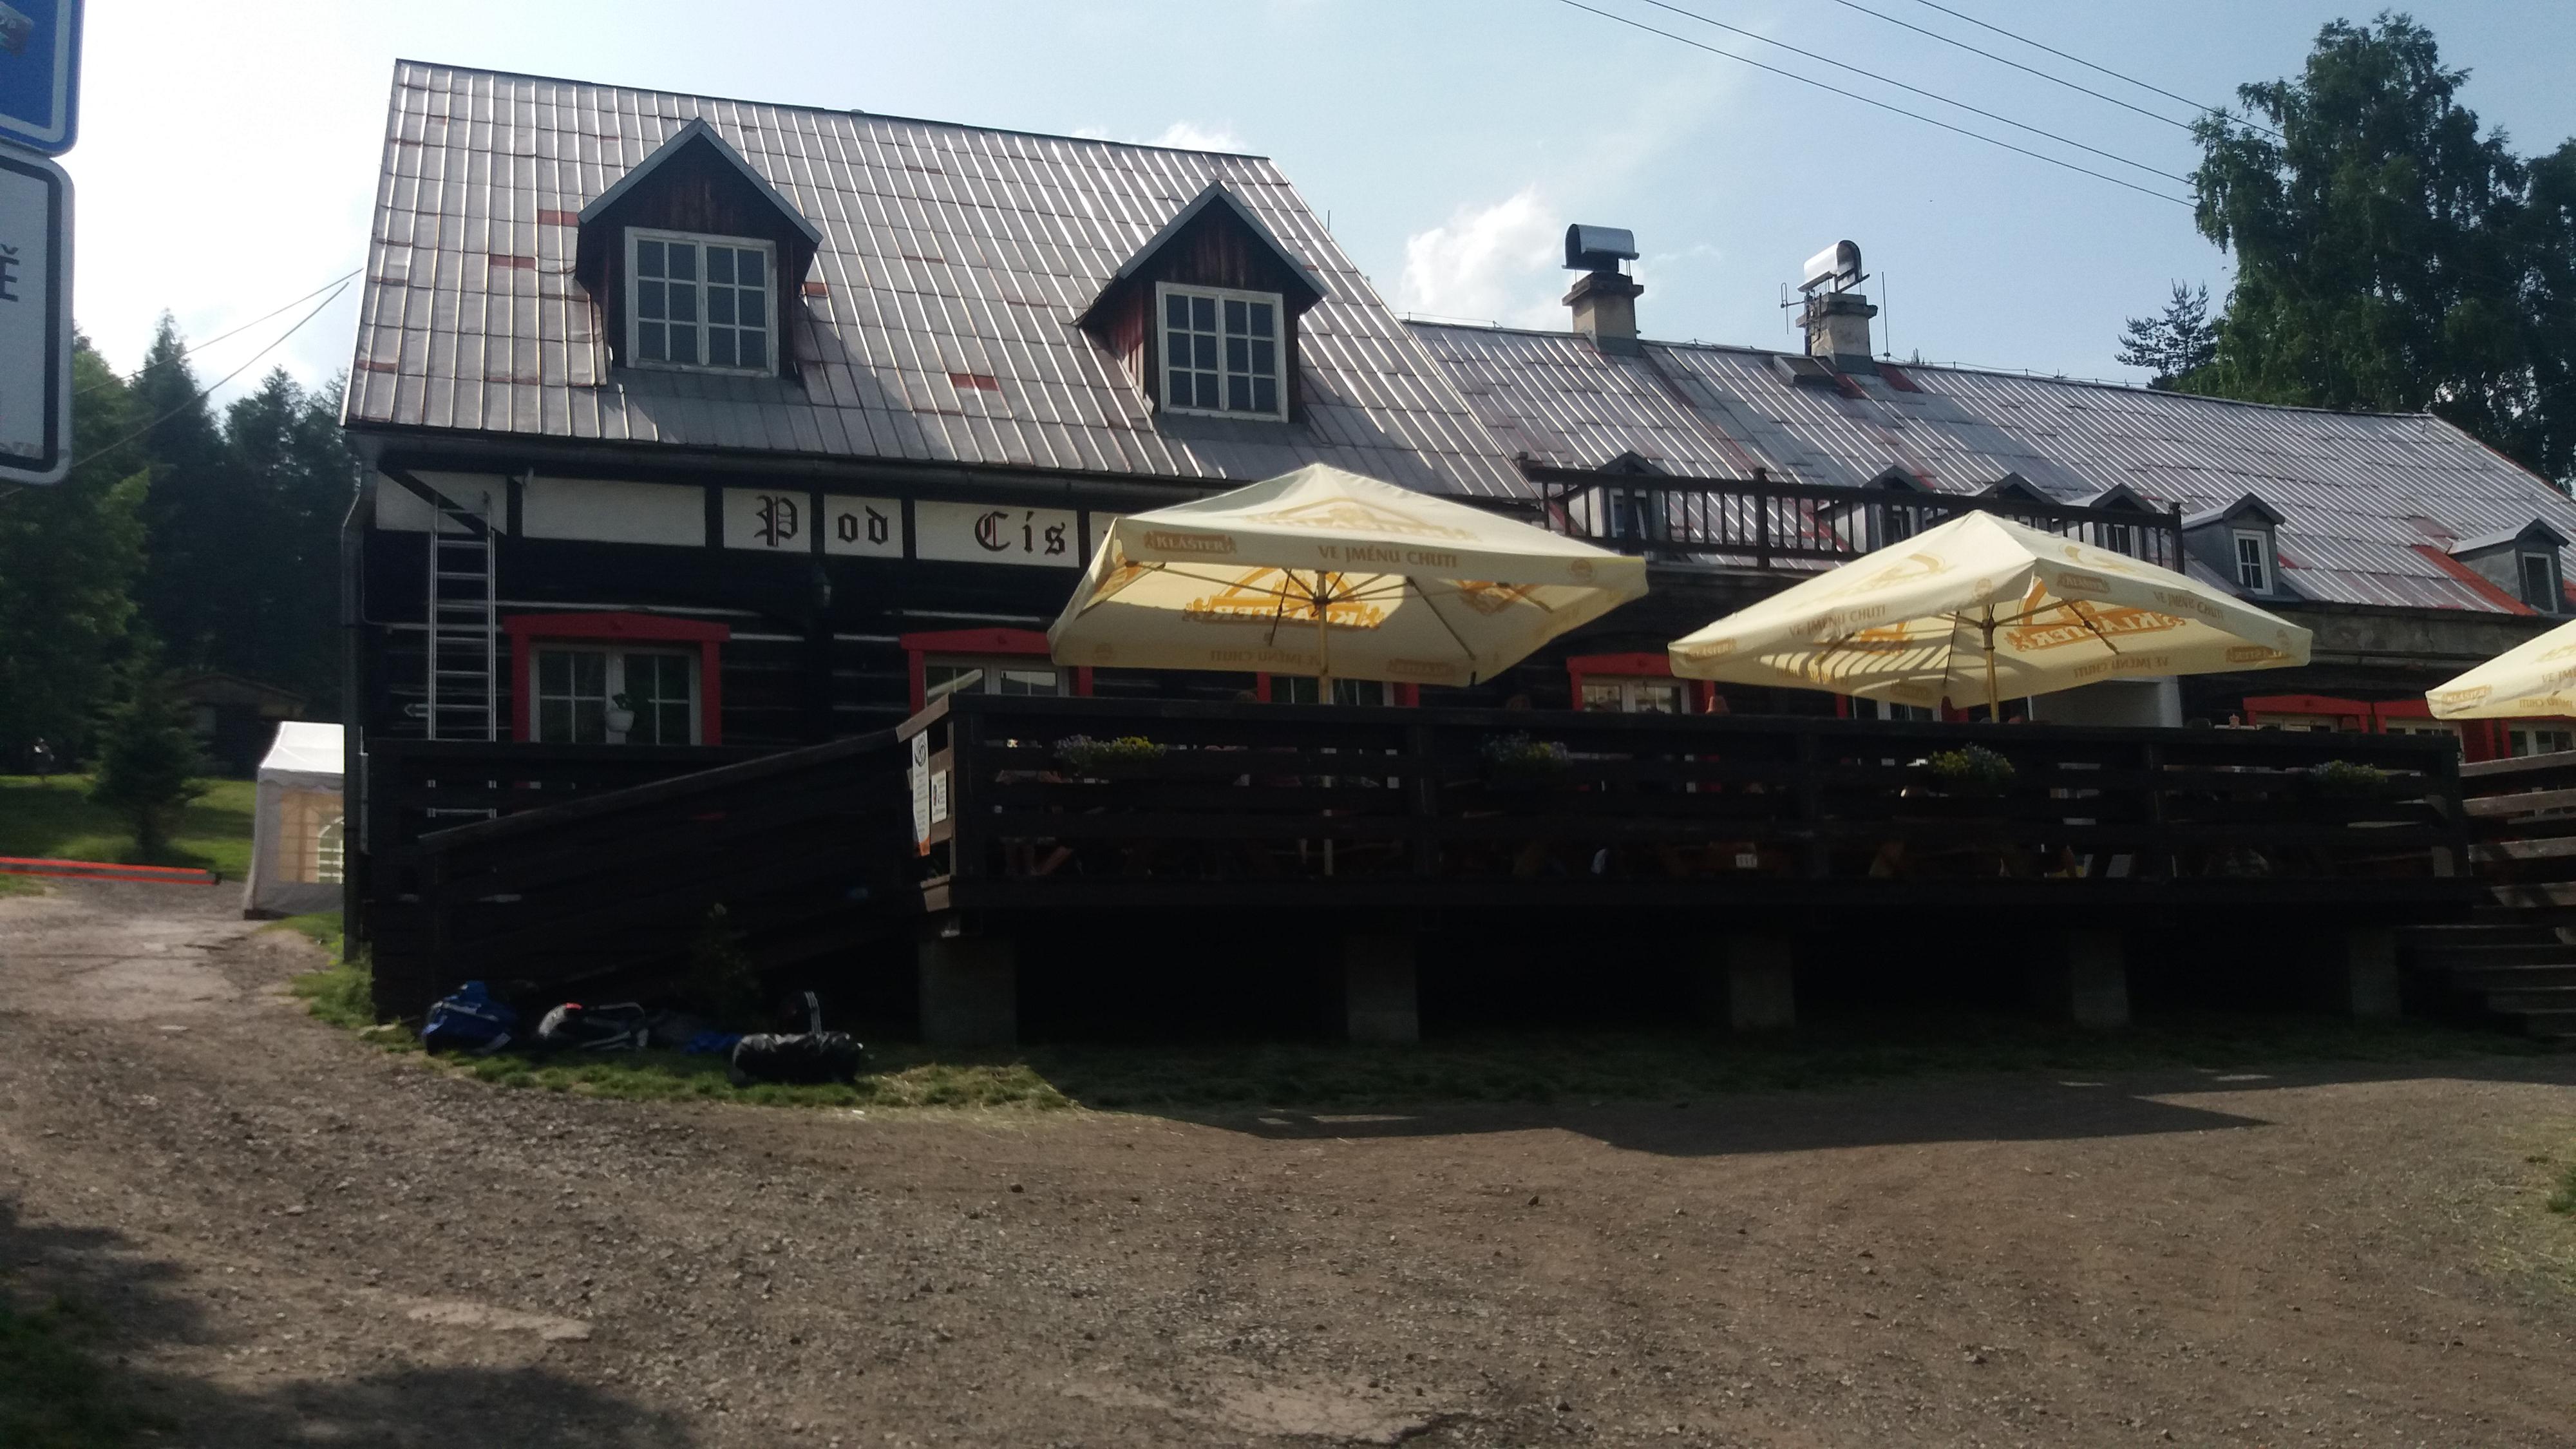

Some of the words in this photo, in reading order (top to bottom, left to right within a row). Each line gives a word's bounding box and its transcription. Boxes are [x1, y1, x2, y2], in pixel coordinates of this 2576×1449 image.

[754, 495, 889, 547] Pod
[974, 510, 1110, 556] Cís
[1318, 545, 1340, 559] VE
[1406, 551, 1457, 567] CHUTI
[1849, 604, 1886, 622] CHUTI
